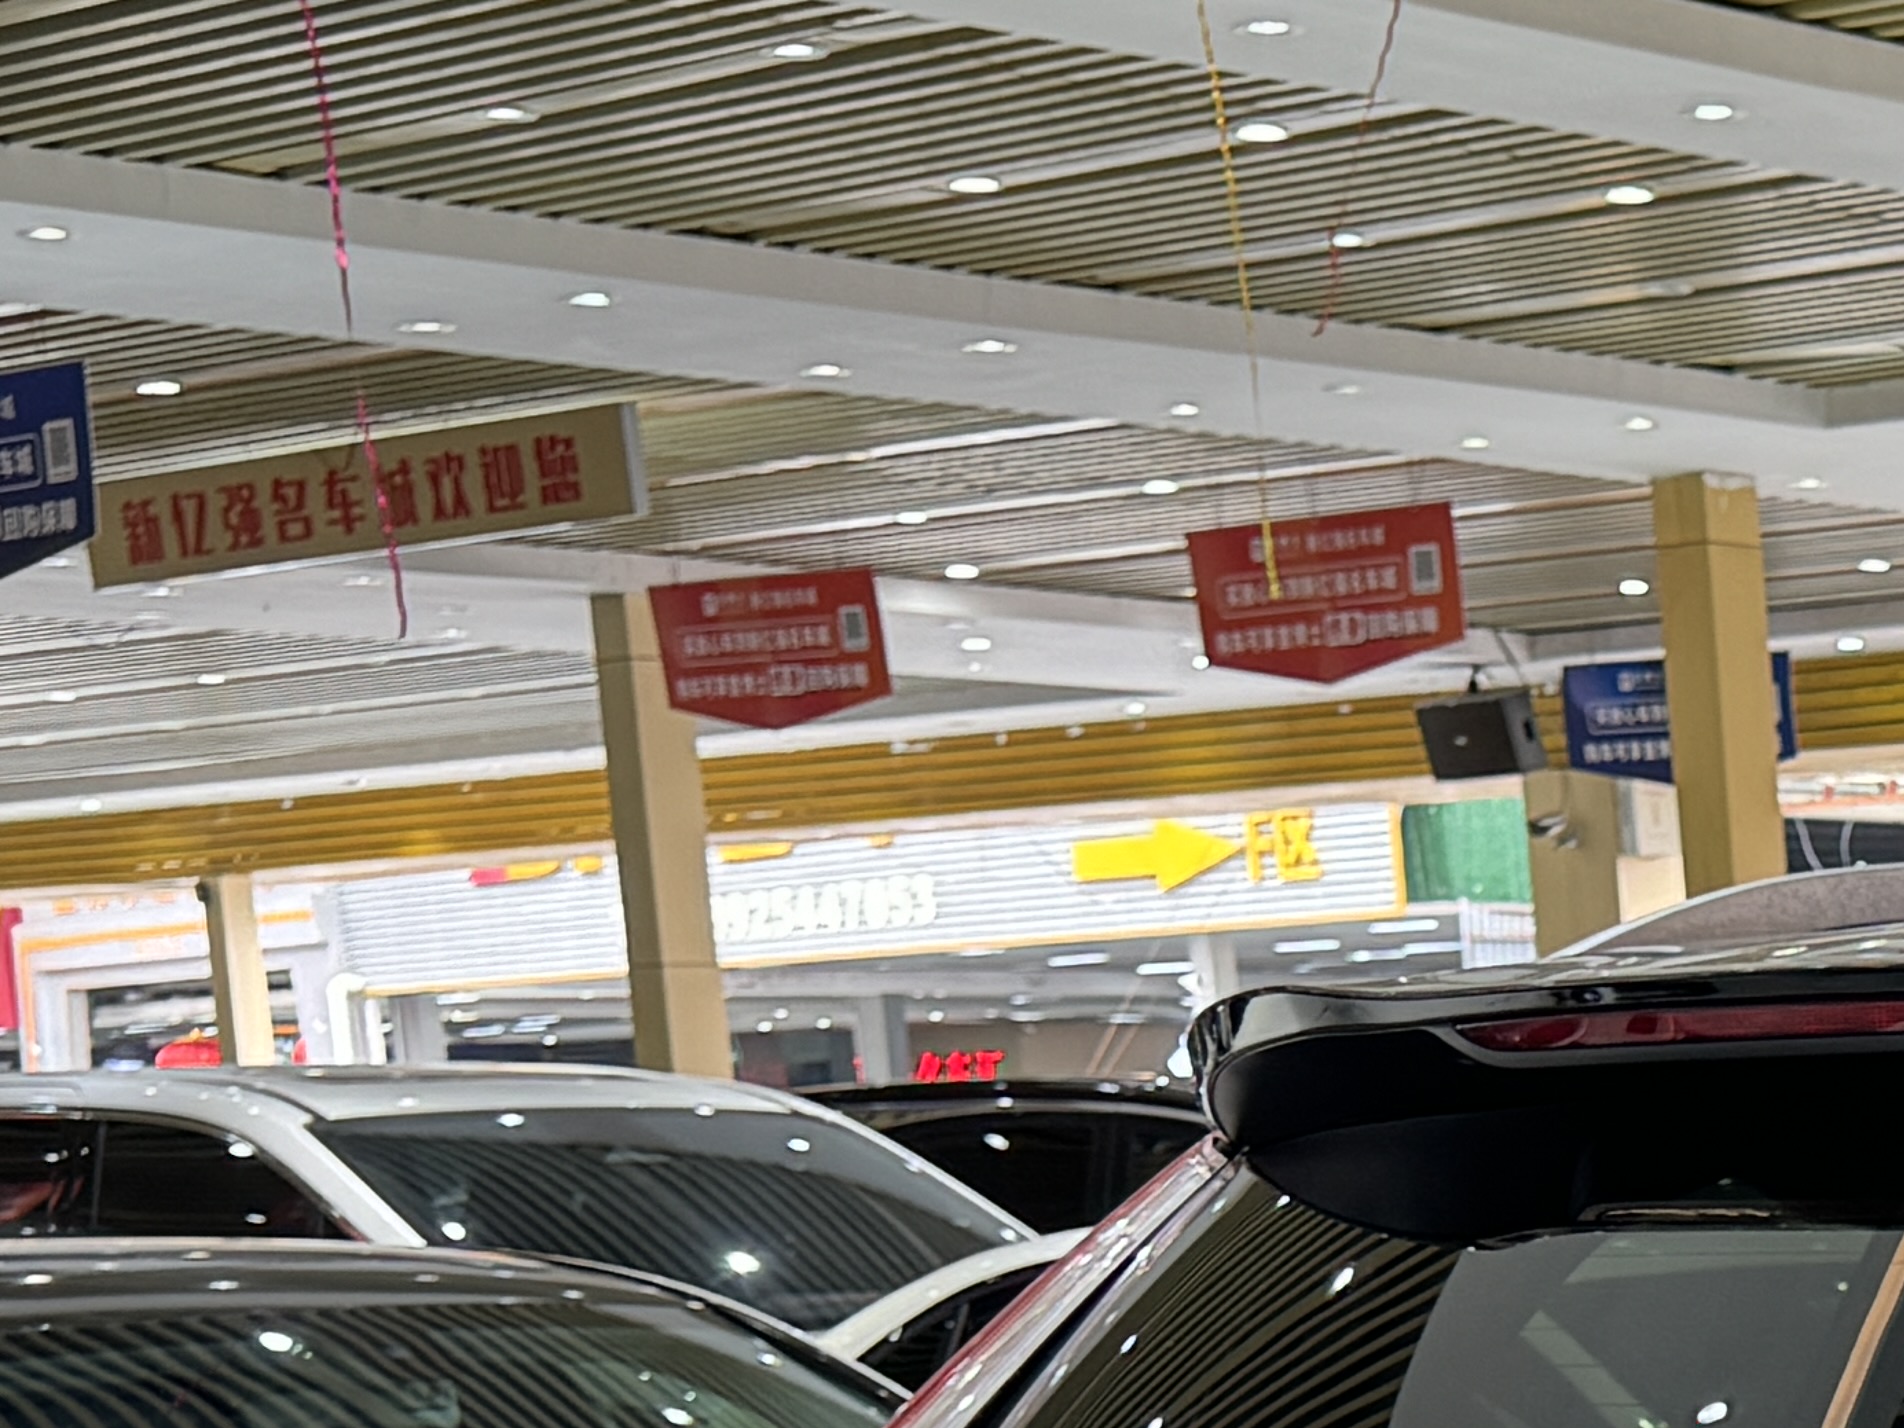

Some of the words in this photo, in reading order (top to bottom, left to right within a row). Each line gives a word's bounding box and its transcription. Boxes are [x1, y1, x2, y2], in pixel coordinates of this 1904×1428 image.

[120, 433, 584, 566] 新亿强名车城欢迎您
